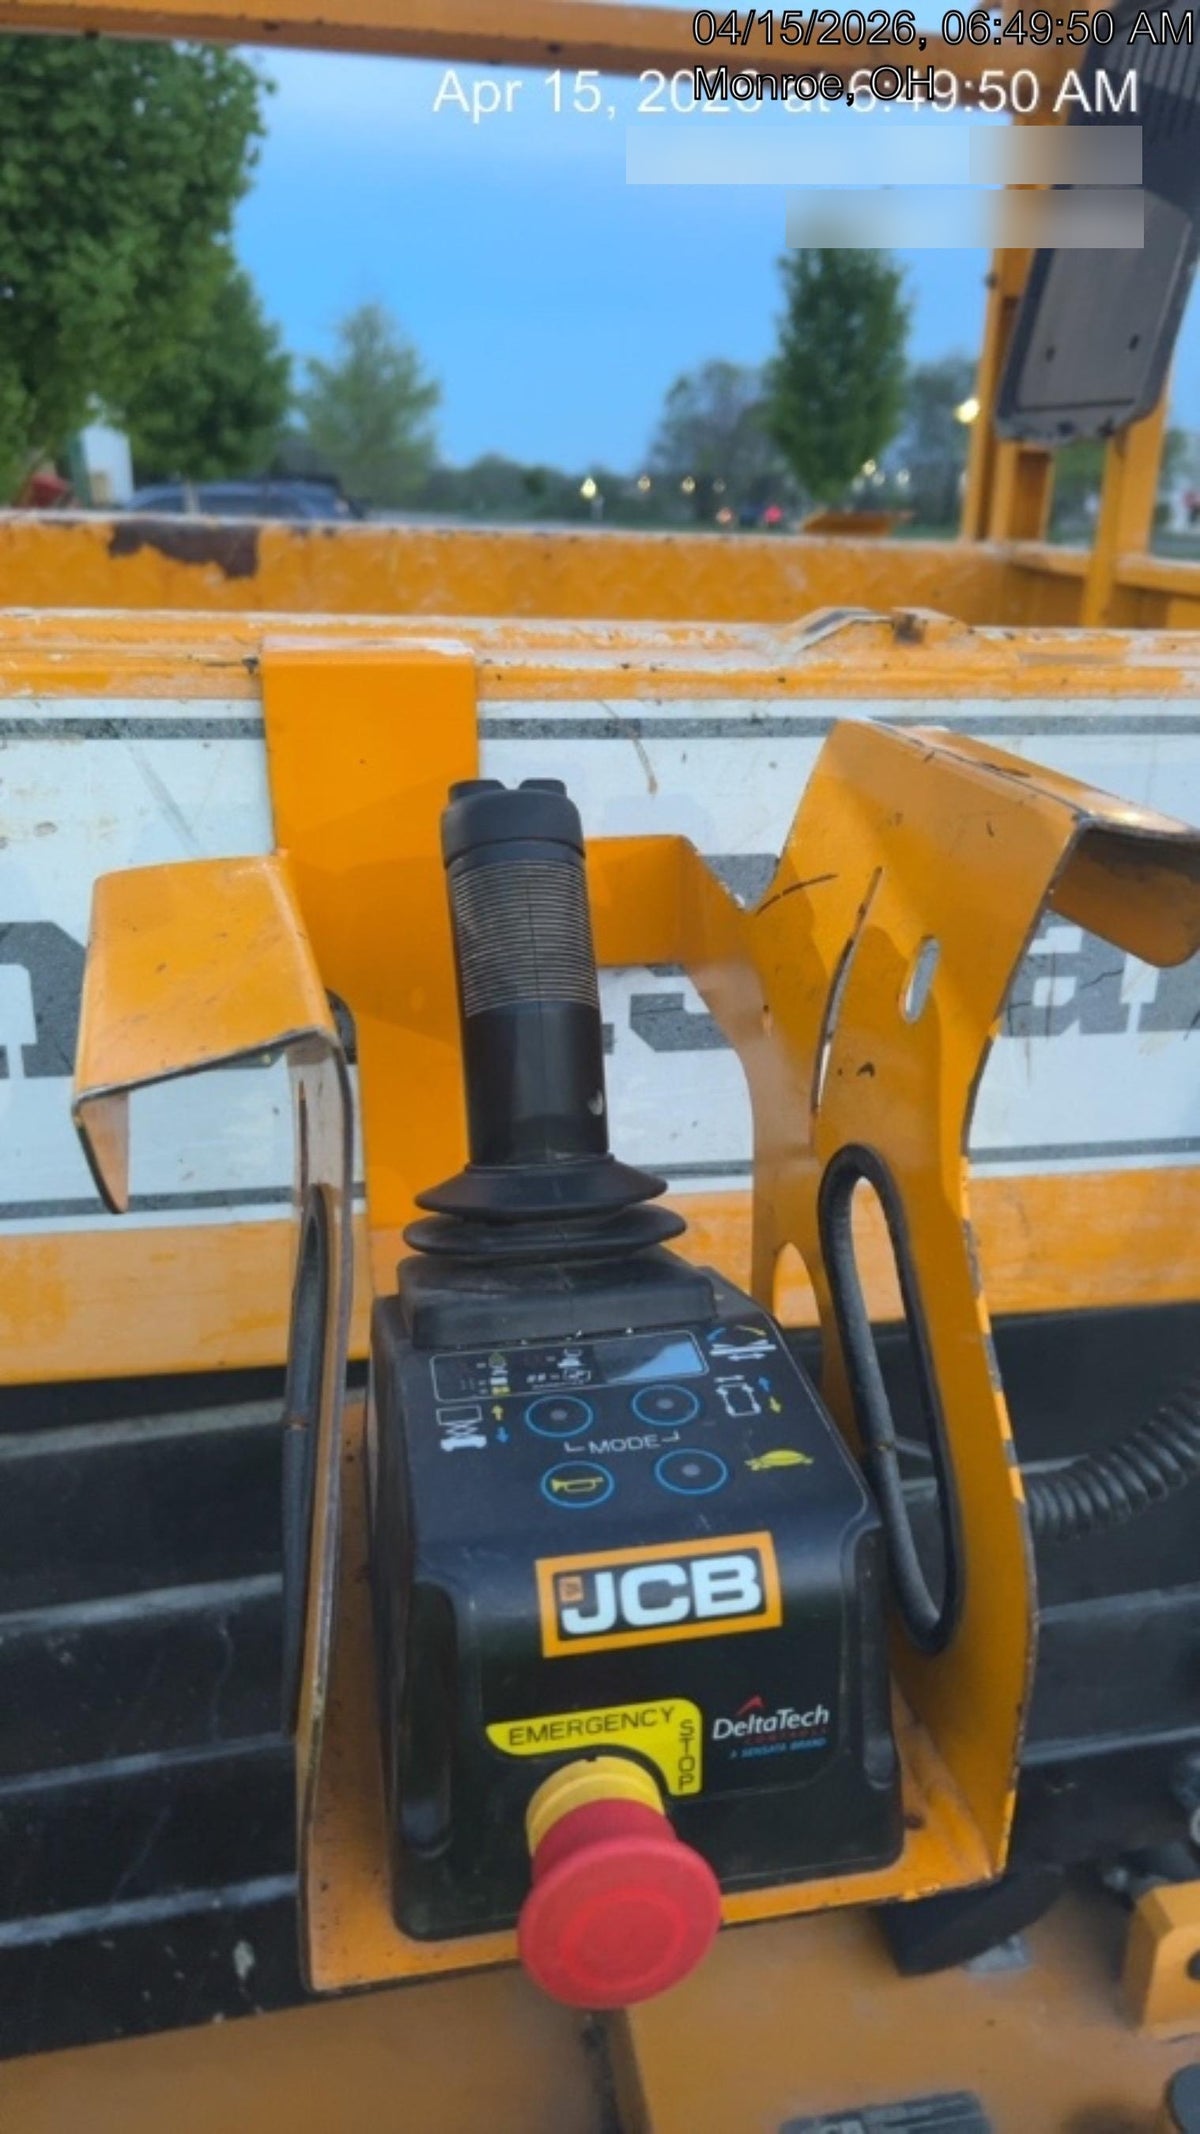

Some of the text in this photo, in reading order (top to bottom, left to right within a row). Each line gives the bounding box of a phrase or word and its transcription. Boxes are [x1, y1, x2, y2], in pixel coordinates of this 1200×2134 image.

[588, 1434, 660, 1454] MODE
[560, 1554, 762, 1635] JCB
[509, 1706, 675, 1746] EMERGENCY
[712, 1704, 829, 1740] DeltaTech
[678, 1719, 696, 1792] STOP
